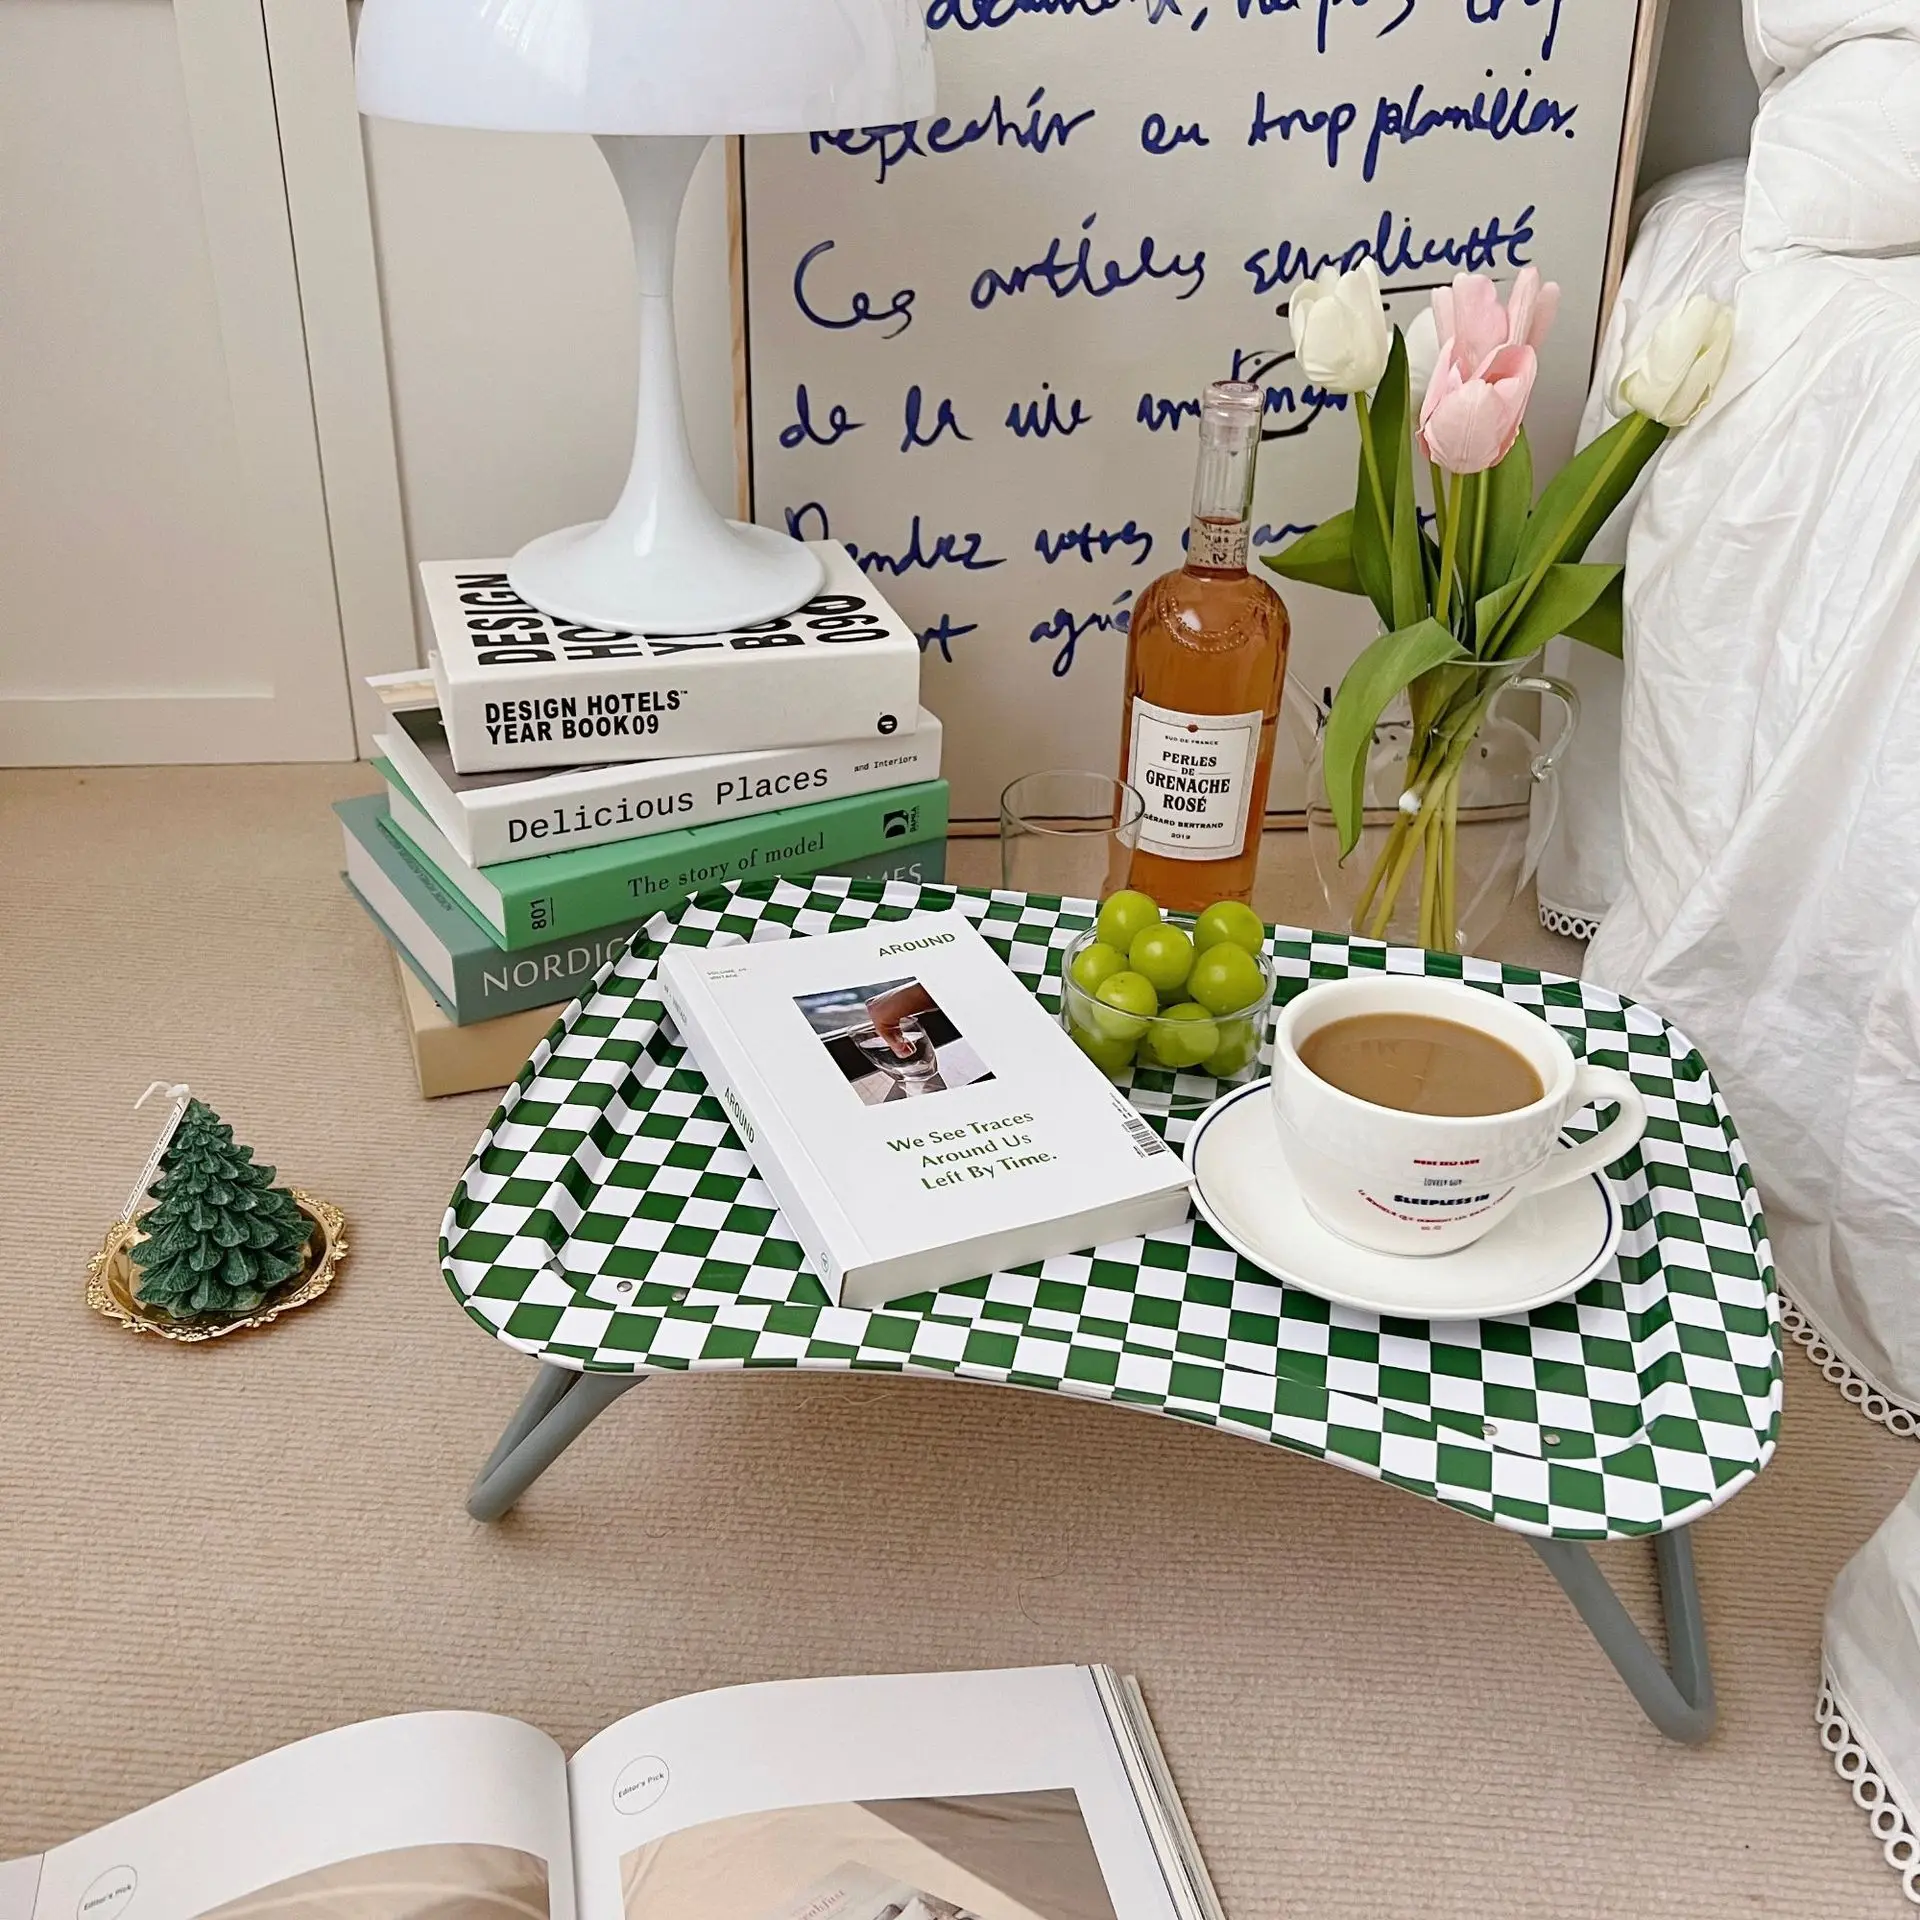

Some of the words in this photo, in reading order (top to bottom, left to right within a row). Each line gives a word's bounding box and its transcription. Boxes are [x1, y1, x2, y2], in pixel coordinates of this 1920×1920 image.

[794, 240, 915, 339] Ces
[779, 383, 866, 448] de
[900, 385, 974, 453] la
[455, 574, 556, 665] DESIGN
[485, 697, 577, 724] DESIGN
[485, 721, 553, 745] YEAR
[1162, 751, 1217, 767] PERLES
[1181, 767, 1195, 776] DE
[1146, 770, 1231, 794] GRENACHE
[508, 791, 694, 844] Delicious
[716, 767, 829, 806] Places
[854, 762, 869, 773] and
[873, 754, 918, 769] Interiors
[1162, 793, 1207, 813] ROSÉ
[1178, 821, 1224, 829] BERTRAND
[628, 876, 670, 897] The
[678, 861, 730, 889] story
[738, 848, 760, 871] of
[764, 832, 824, 862] model
[530, 898, 547, 930] 801
[878, 932, 957, 958] AROUND
[723, 1086, 755, 1145] AROUND
[886, 1136, 925, 1152] We
[928, 1127, 967, 1144] See
[967, 1111, 1035, 1135] Traces
[921, 1139, 999, 1168] Around
[1002, 1133, 1033, 1148] Us
[921, 1169, 965, 1190] Left
[966, 1164, 996, 1180] By
[996, 1151, 1058, 1172] Time.
